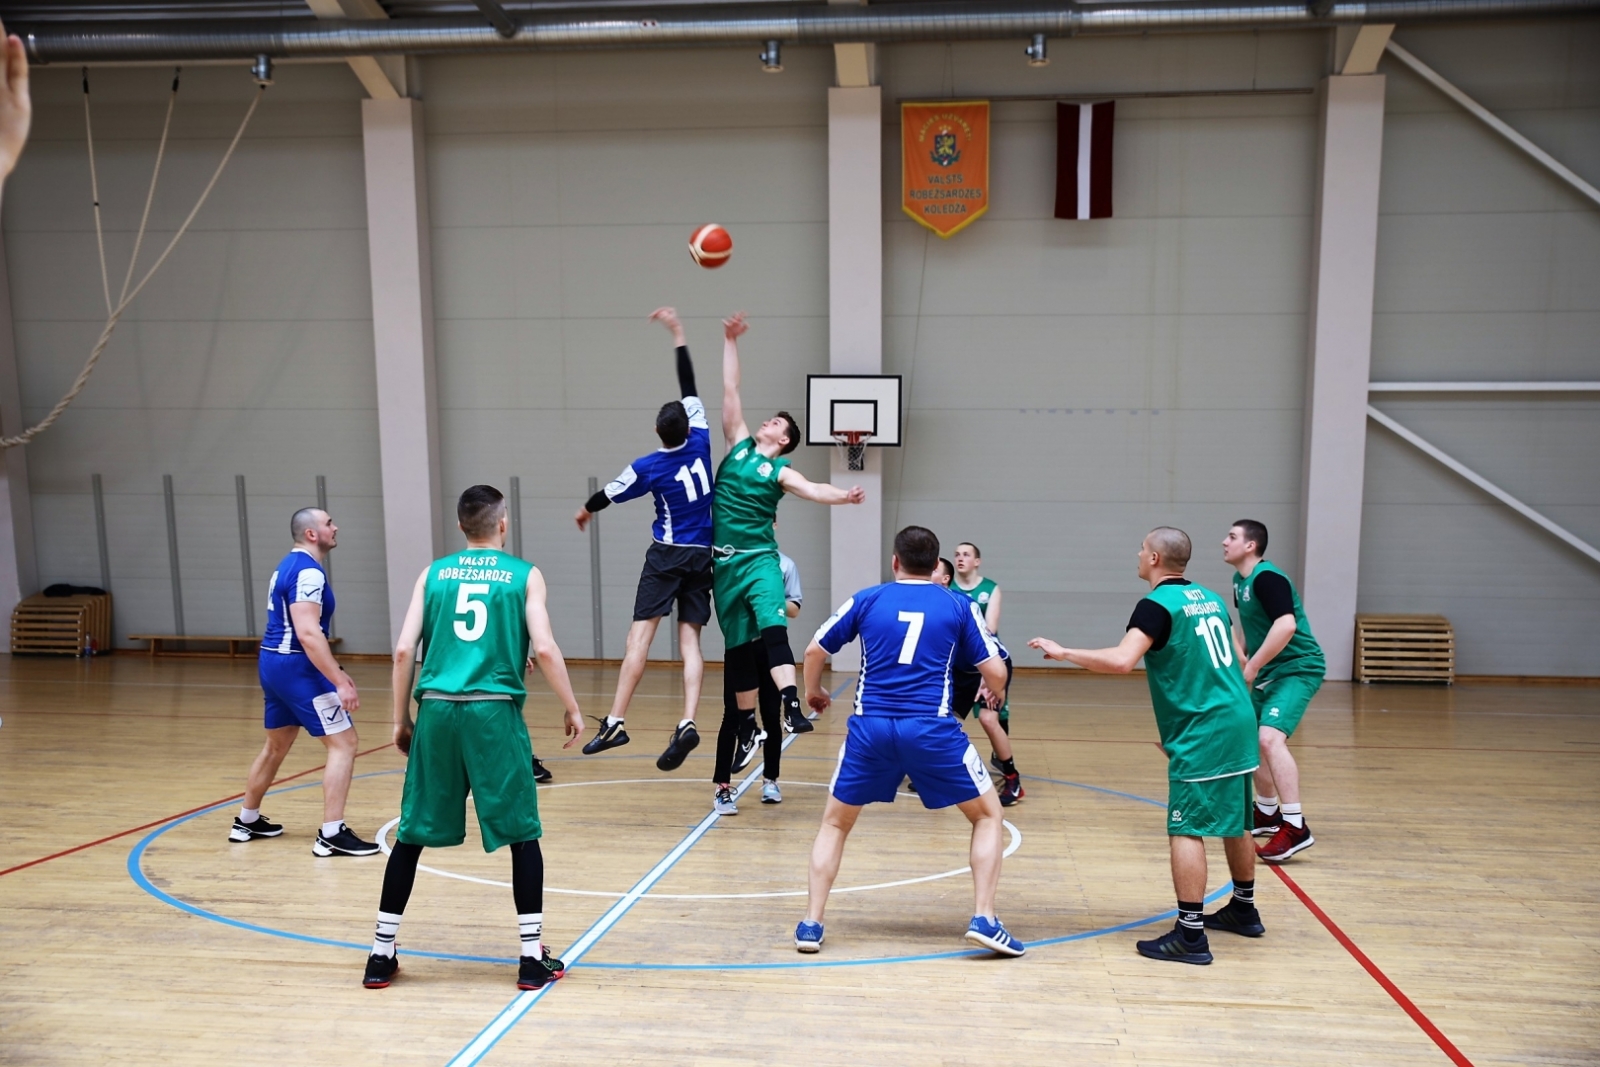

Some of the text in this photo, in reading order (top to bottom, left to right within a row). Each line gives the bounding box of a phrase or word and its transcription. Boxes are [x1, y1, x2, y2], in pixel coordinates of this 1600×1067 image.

[927, 174, 964, 185] VALSTS
[909, 188, 981, 200] ROBEŽSARDZES
[924, 203, 967, 214] KOLEDŽA
[674, 457, 711, 503] 11
[458, 555, 498, 567] VALSTS
[438, 565, 514, 584] ROBEŽSARDZE
[453, 582, 490, 642] 5
[897, 610, 925, 665] 7
[1194, 615, 1233, 669] 10
